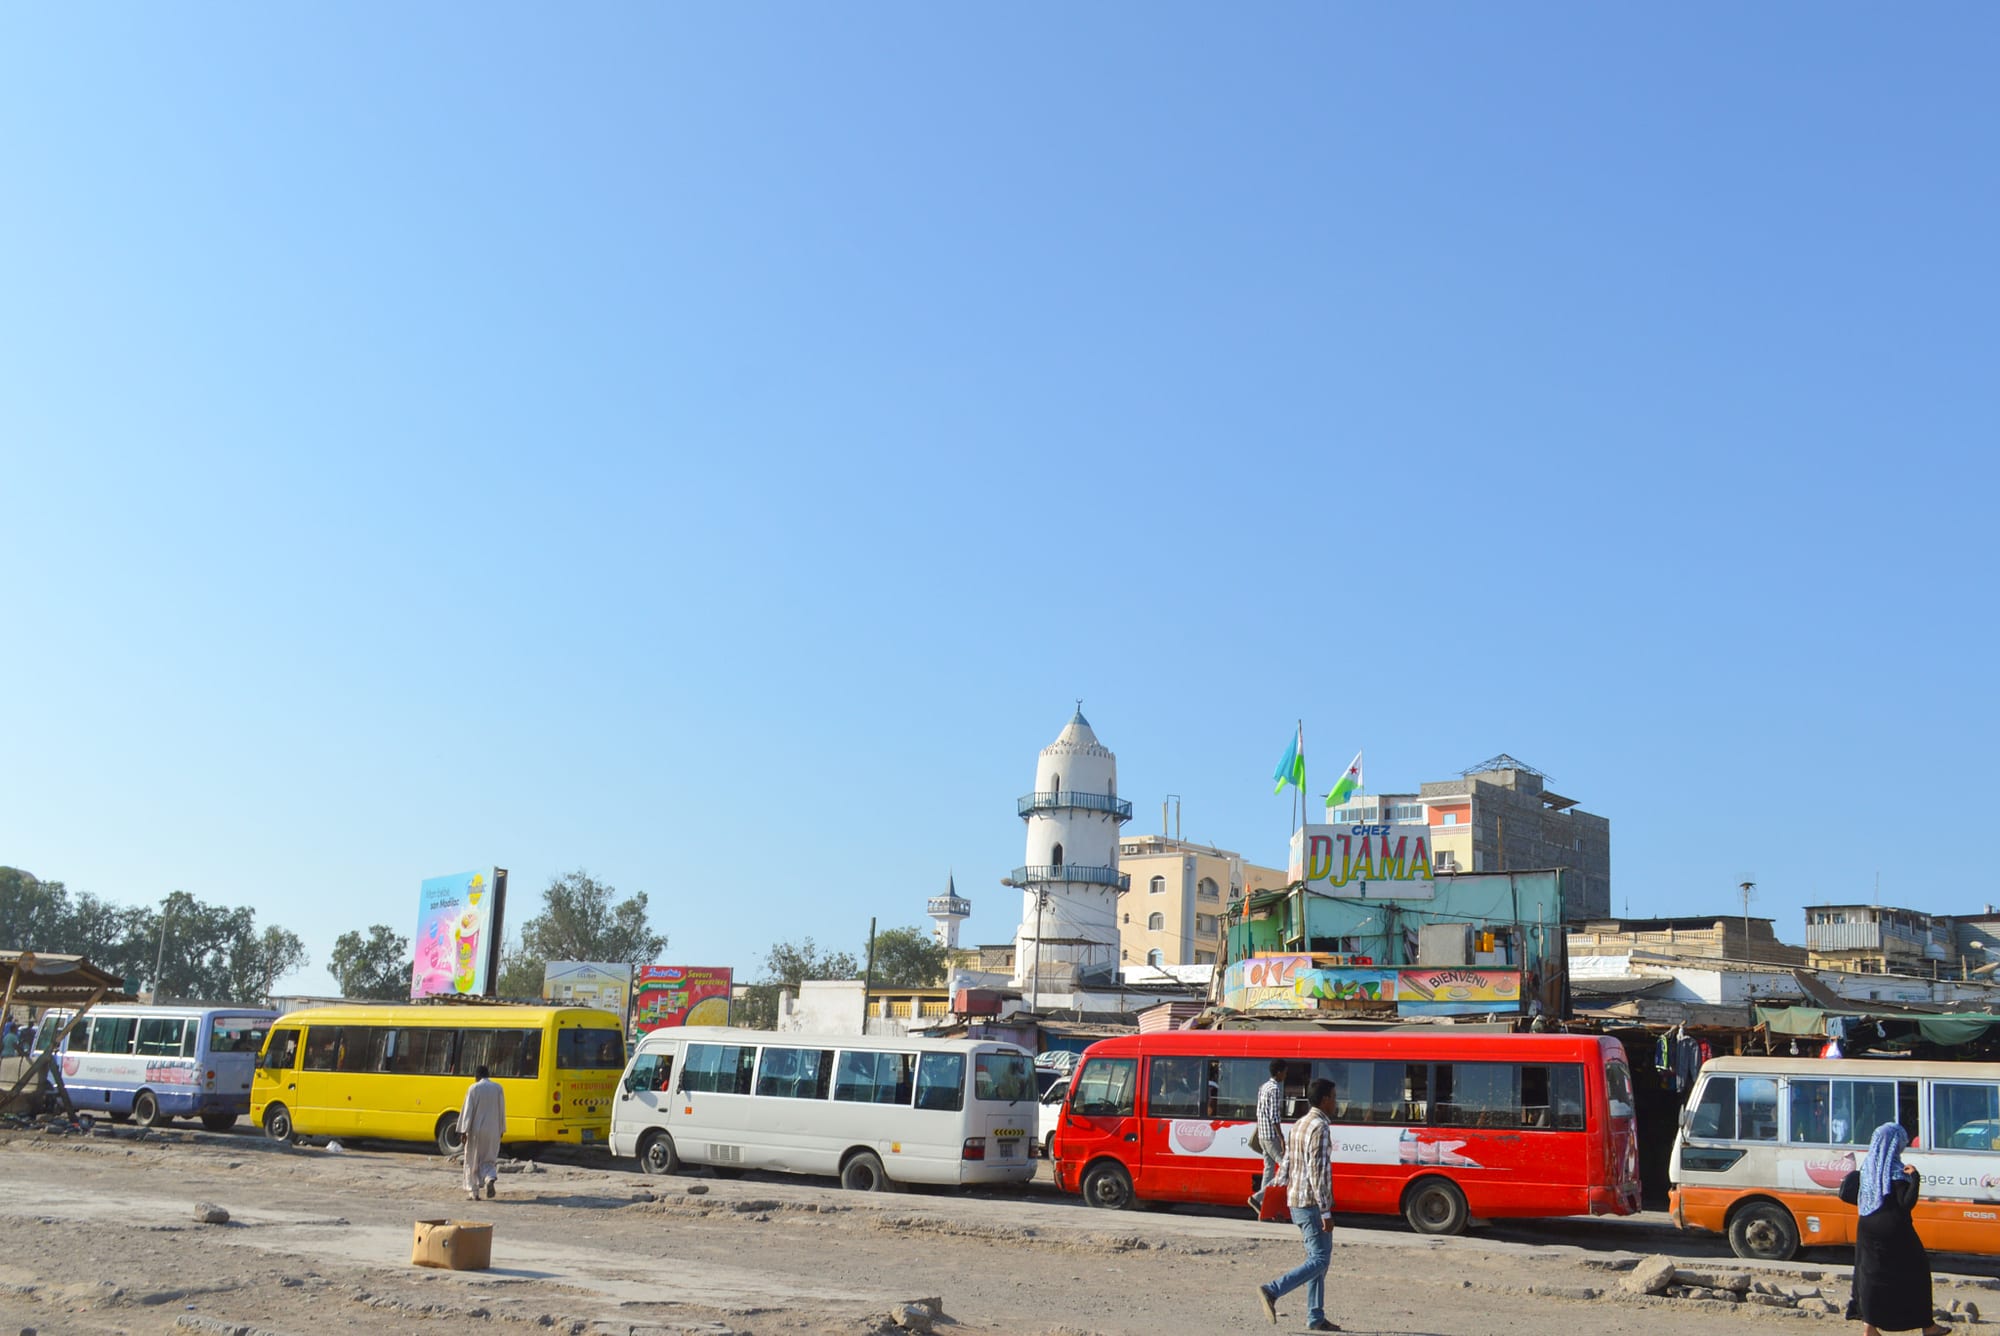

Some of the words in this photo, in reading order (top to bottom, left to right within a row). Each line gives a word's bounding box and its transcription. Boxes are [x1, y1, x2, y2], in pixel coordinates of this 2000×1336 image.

[1352, 825, 1391, 836] CHEZ
[1307, 834, 1434, 887] DJAMA
[1429, 971, 1488, 988] BIENVENU
[1177, 1123, 1212, 1137] Coca-Cola
[1960, 1177, 1977, 1186] un
[1963, 1211, 1997, 1220] ROSA
